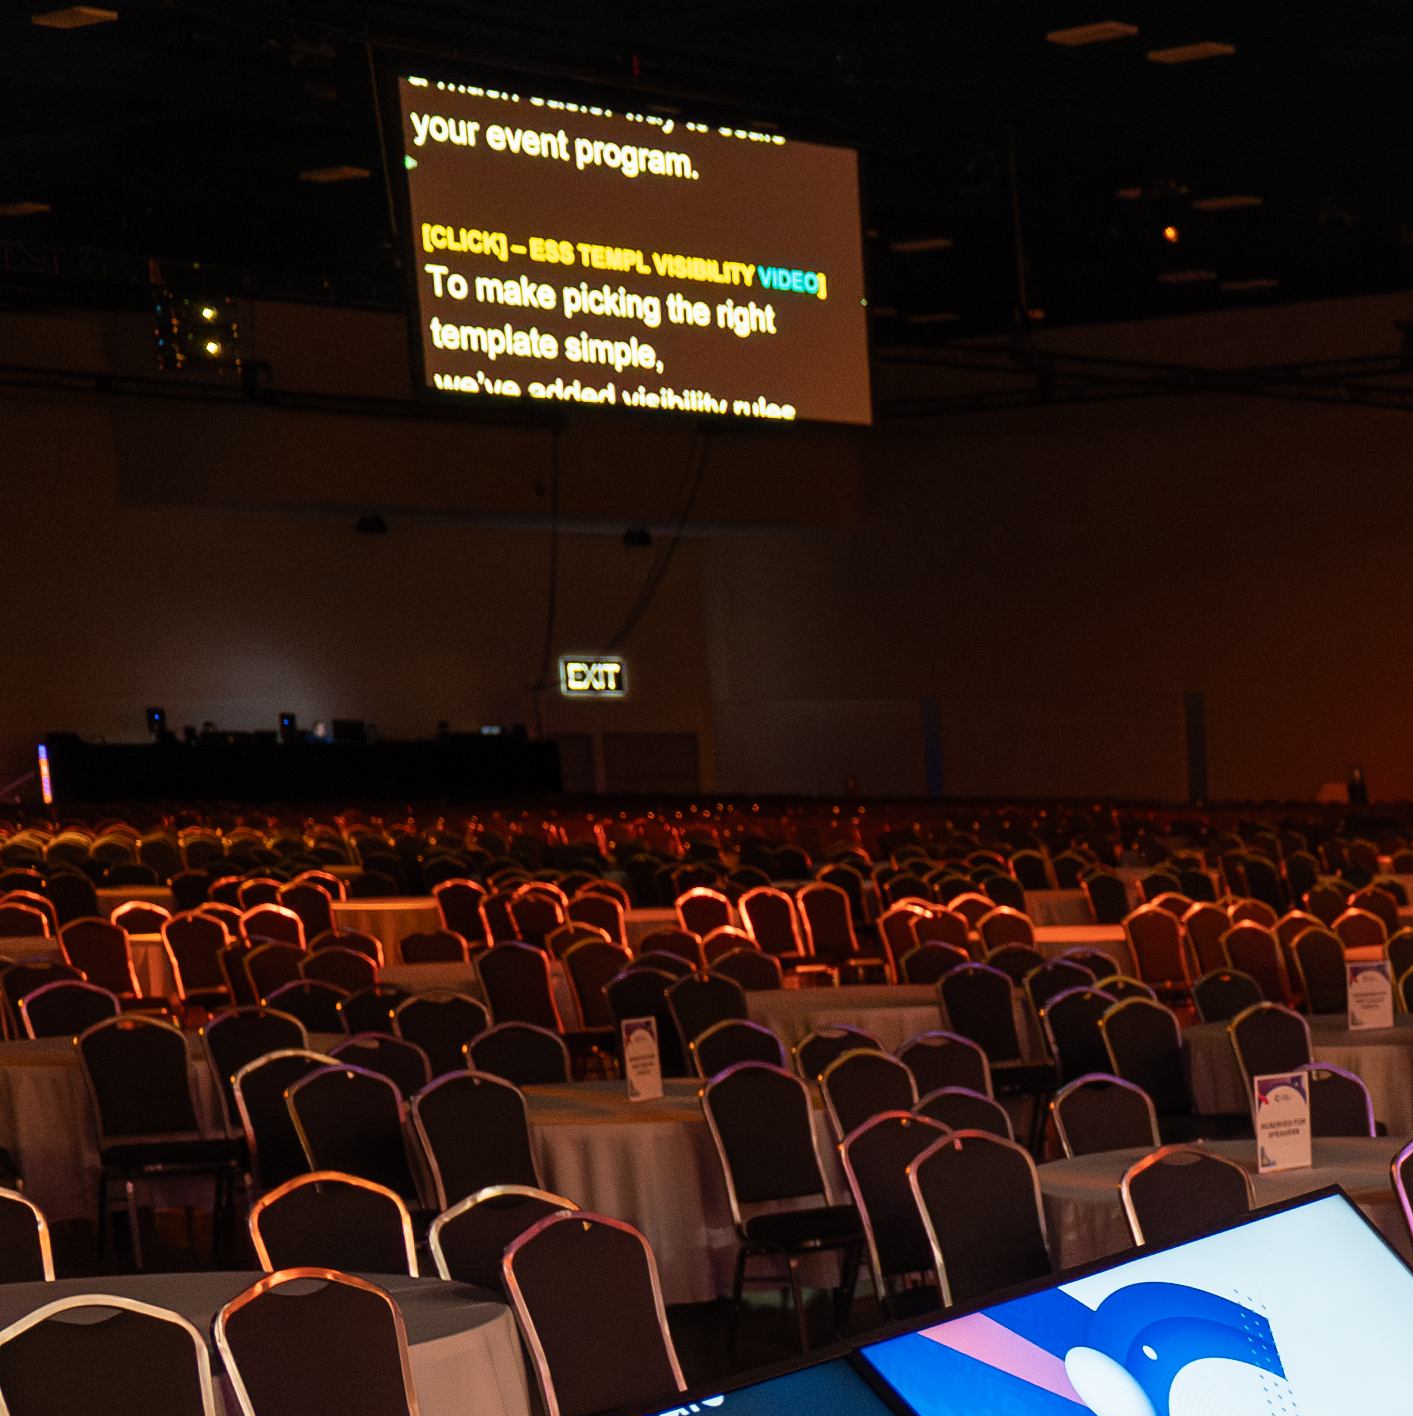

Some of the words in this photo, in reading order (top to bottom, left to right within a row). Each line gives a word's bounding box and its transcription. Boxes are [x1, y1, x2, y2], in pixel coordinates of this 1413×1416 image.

[409, 111, 481, 147] your
[485, 124, 571, 162] event
[574, 137, 700, 180] program.
[421, 222, 509, 263] [CLICK]
[528, 236, 576, 266] ESS
[575, 242, 652, 275] TEMPL
[651, 251, 756, 287] VISIBILITY
[756, 265, 828, 300] VIDEO]
[423, 263, 469, 300] To
[474, 274, 557, 310] make
[562, 281, 662, 329] picking
[665, 292, 712, 327] the
[715, 298, 777, 338] right
[429, 316, 559, 361] template
[563, 330, 664, 375] simple,
[566, 662, 621, 691] EXIT
